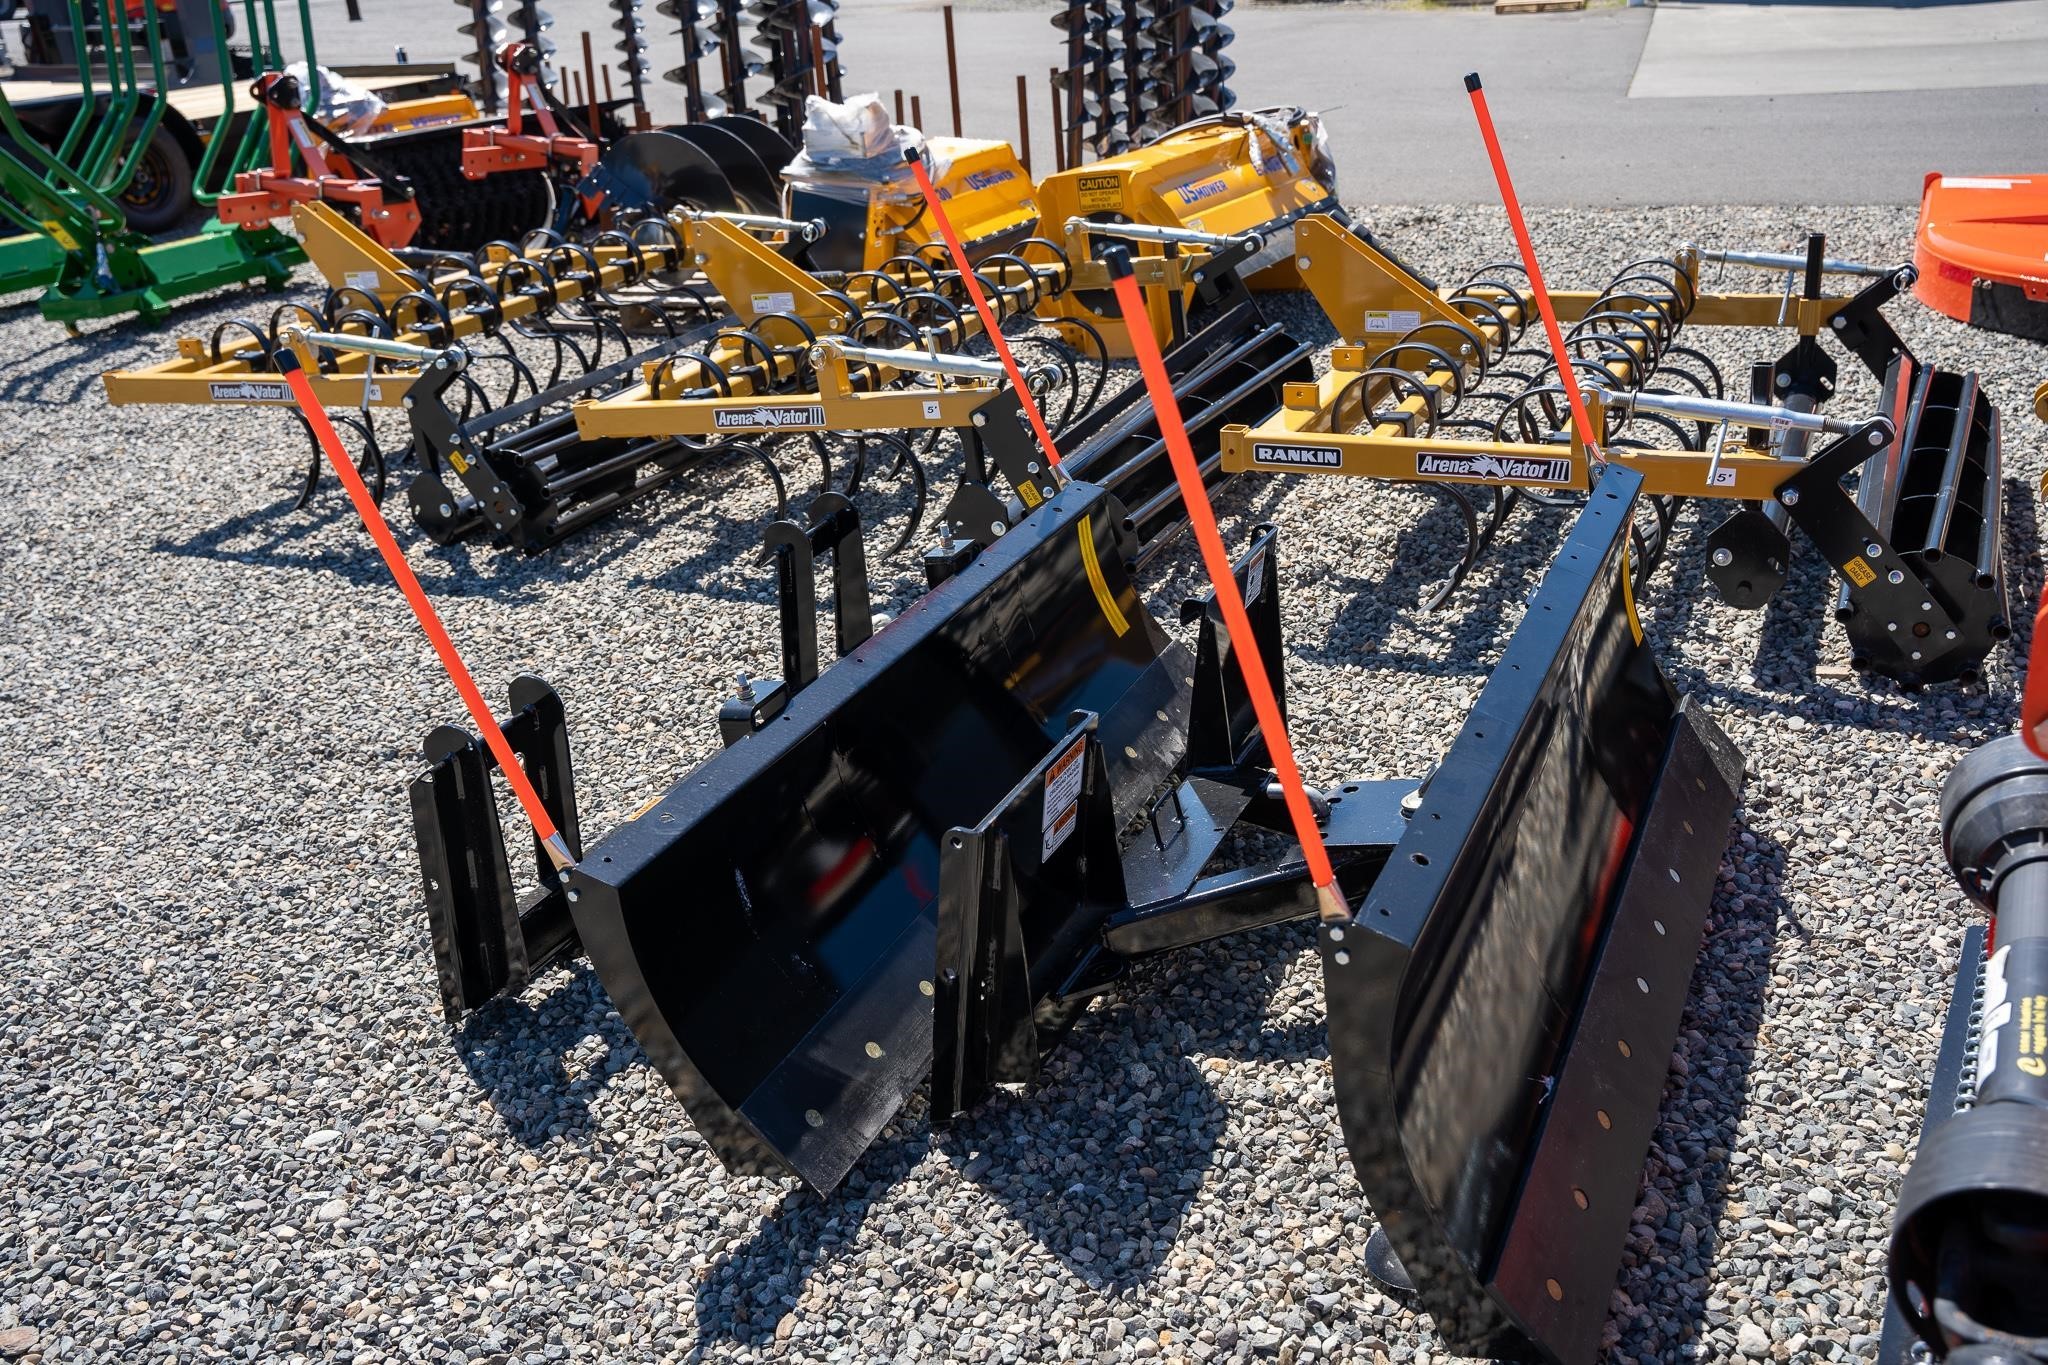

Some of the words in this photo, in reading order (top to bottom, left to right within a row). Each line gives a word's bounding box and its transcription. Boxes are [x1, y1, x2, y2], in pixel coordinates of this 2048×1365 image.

[1080, 177, 1118, 189] CAUTION
[213, 385, 241, 398] Arena
[255, 385, 282, 399] Vator
[718, 411, 753, 425] Arena
[775, 409, 808, 425] Vator
[809, 407, 823, 425] III
[1258, 447, 1337, 464] RANKIN
[1420, 455, 1469, 474] Arena
[1502, 459, 1548, 478] Vator
[1548, 460, 1569, 481] III
[1716, 473, 1733, 482] 5'
[1849, 567, 1865, 582] DAILY
[1853, 560, 1873, 581] GREASE
